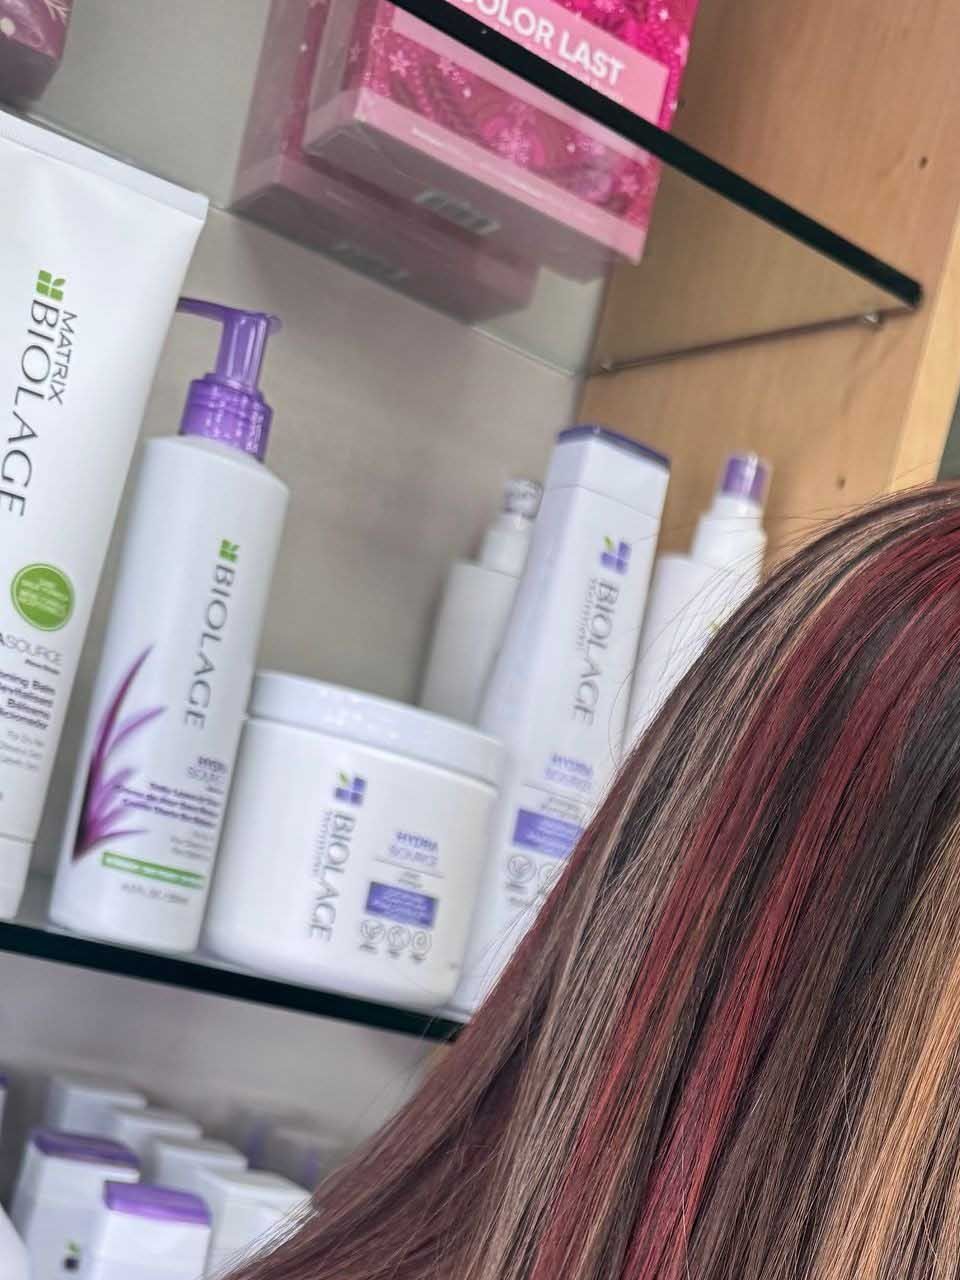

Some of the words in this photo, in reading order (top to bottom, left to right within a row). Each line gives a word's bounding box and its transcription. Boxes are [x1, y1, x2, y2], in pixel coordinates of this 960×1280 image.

[462, 0, 555, 48] OLOR
[557, 31, 626, 86] LAST
[0, 299, 60, 517] BIOLAGE
[47, 309, 78, 406] MATRIX
[184, 563, 236, 731] BIOLAGE
[569, 580, 620, 728] BIOLAGE
[309, 812, 357, 944] BIOLAGE
